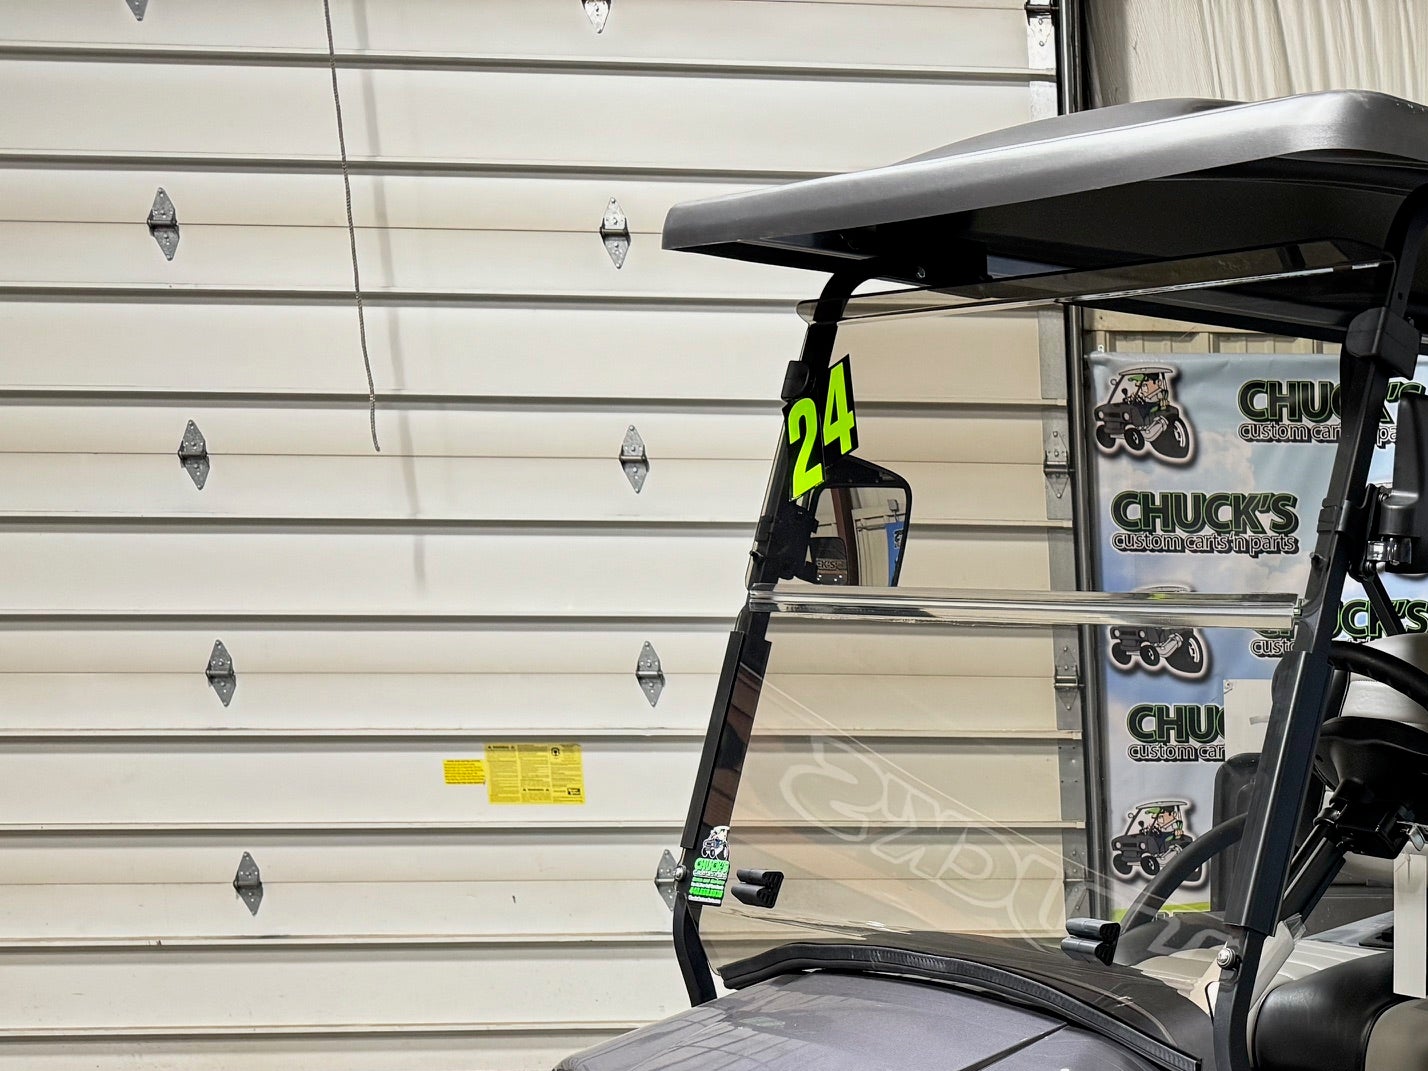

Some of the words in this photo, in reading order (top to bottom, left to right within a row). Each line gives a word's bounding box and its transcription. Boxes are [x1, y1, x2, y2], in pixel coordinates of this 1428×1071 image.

[788, 362, 854, 499] 24
[1240, 423, 1306, 441] custom
[1111, 491, 1299, 534] CHUCK'S
[1113, 532, 1182, 551] custom
[1249, 534, 1296, 557] parts
[1128, 743, 1195, 760] custom
